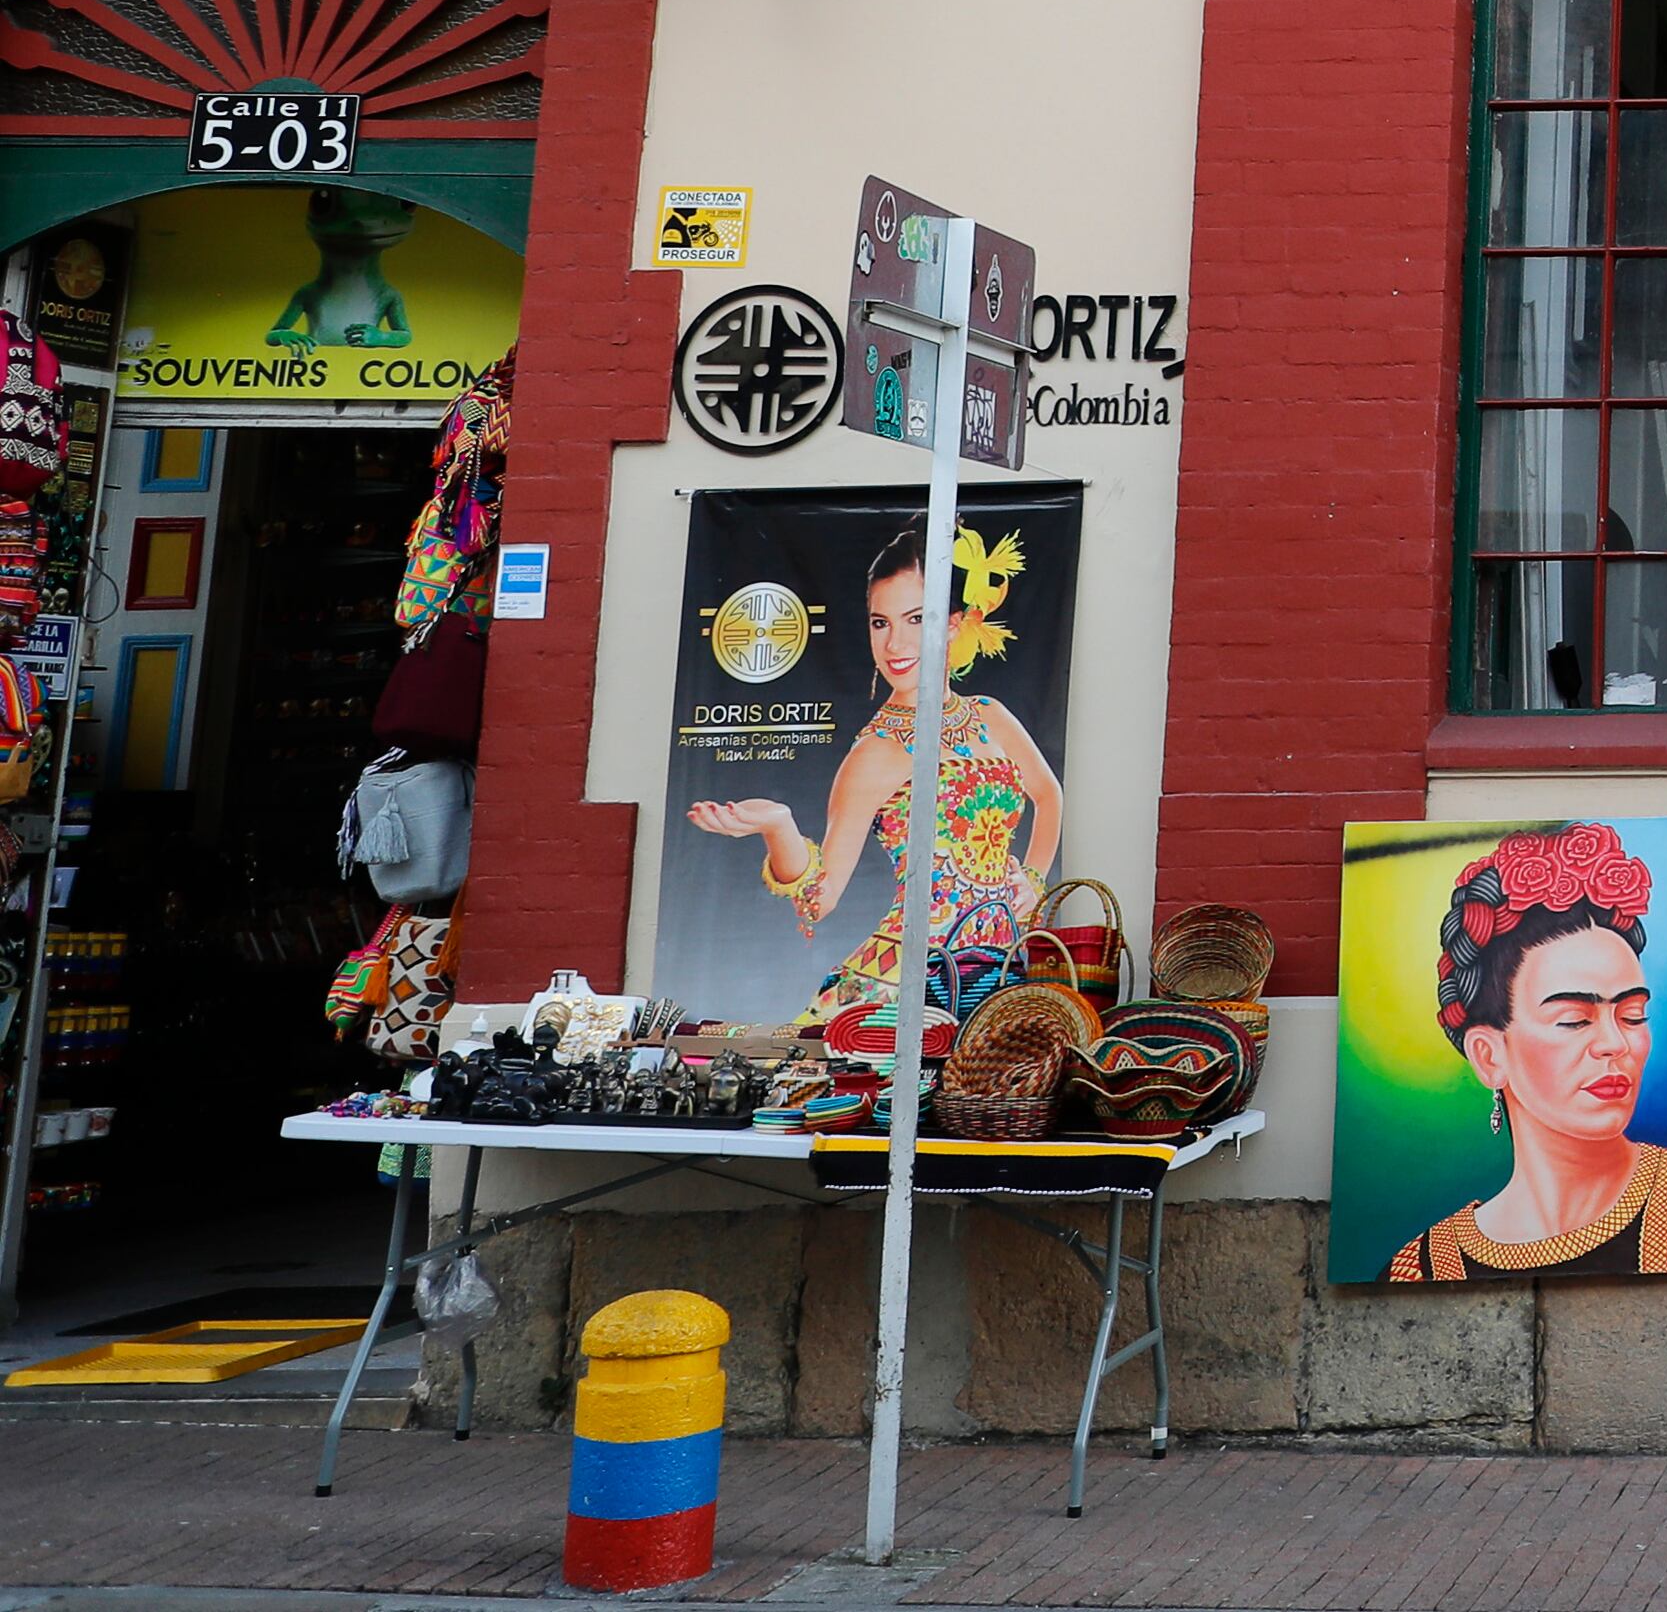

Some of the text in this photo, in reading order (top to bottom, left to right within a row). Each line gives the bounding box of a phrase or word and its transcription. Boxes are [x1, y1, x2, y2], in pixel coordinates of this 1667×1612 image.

[206, 96, 348, 117] Calle 11
[198, 119, 348, 171] 5-03
[669, 192, 742, 202] CONECTADA
[662, 249, 735, 260] PROSEGUR
[76, 307, 112, 326] ORTIZ
[1031, 294, 1177, 362] ORTIZ
[133, 358, 328, 387] SOUVENIRS
[694, 702, 833, 724] DORIS ORTIZ
[751, 732, 833, 746] Colombianas
[715, 745, 796, 762] hand made
